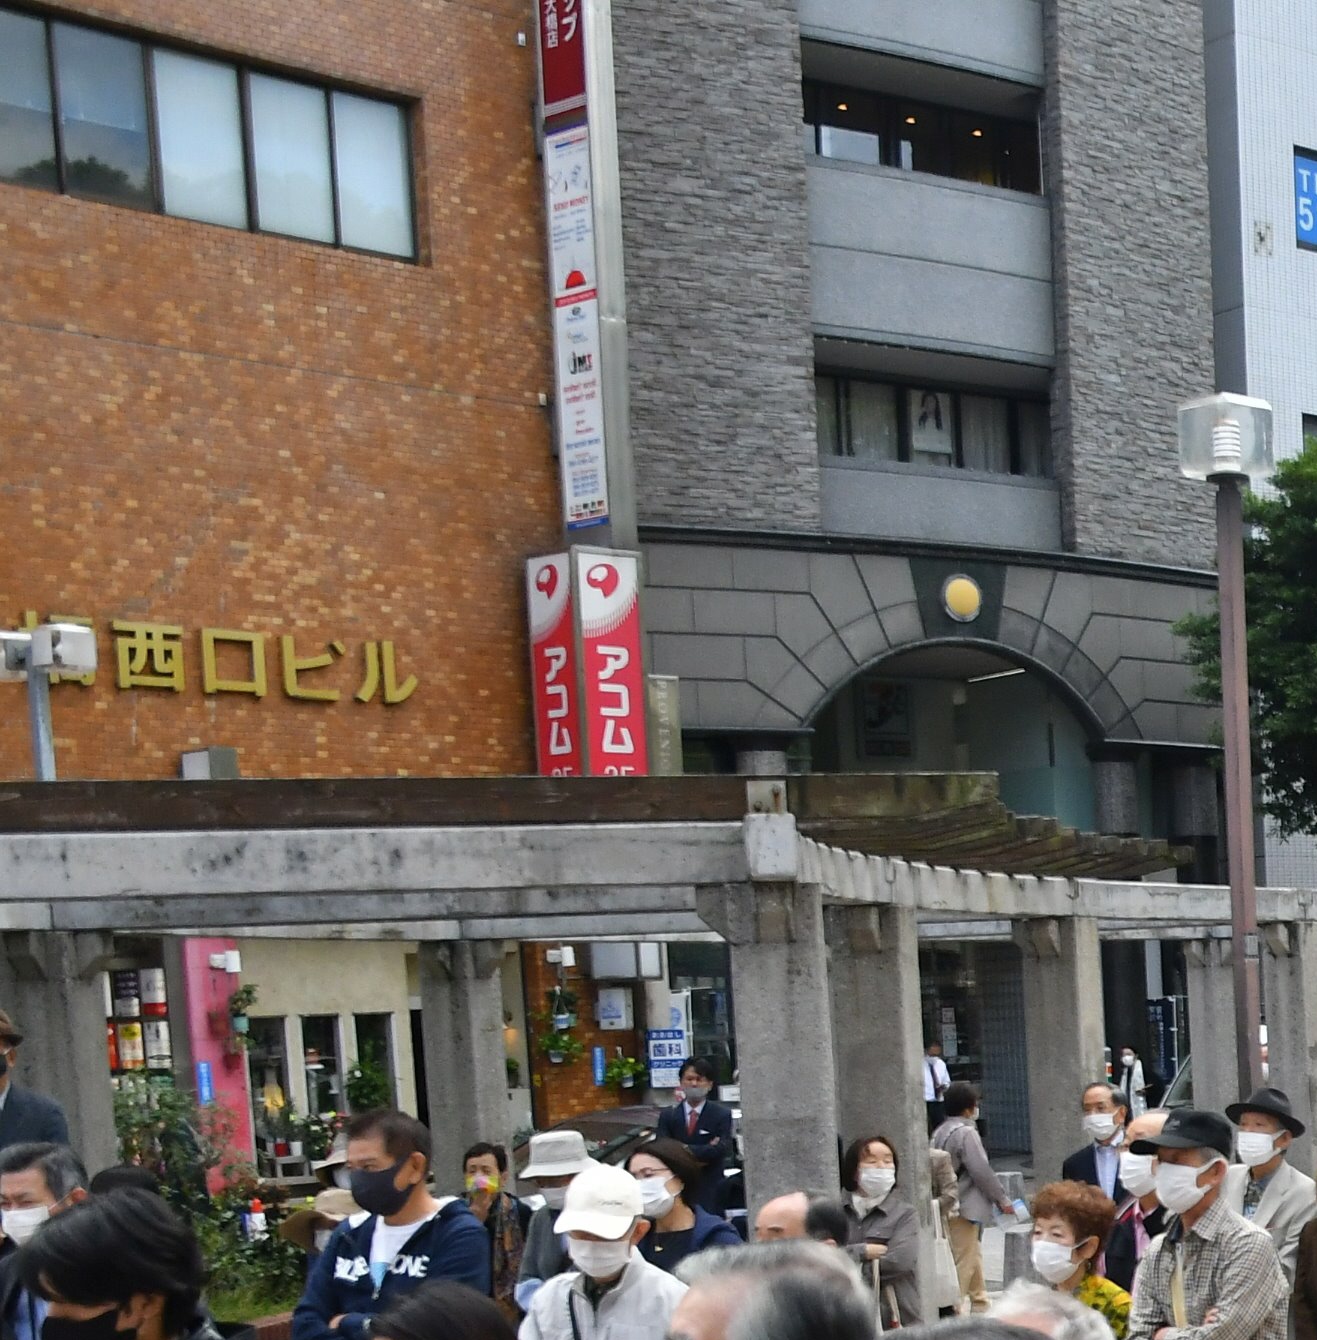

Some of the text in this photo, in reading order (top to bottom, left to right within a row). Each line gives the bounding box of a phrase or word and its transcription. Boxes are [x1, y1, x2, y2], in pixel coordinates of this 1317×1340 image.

[544, 646, 573, 755] アコム
[596, 645, 635, 753] アコム
[653, 1043, 682, 1057] 歯科
